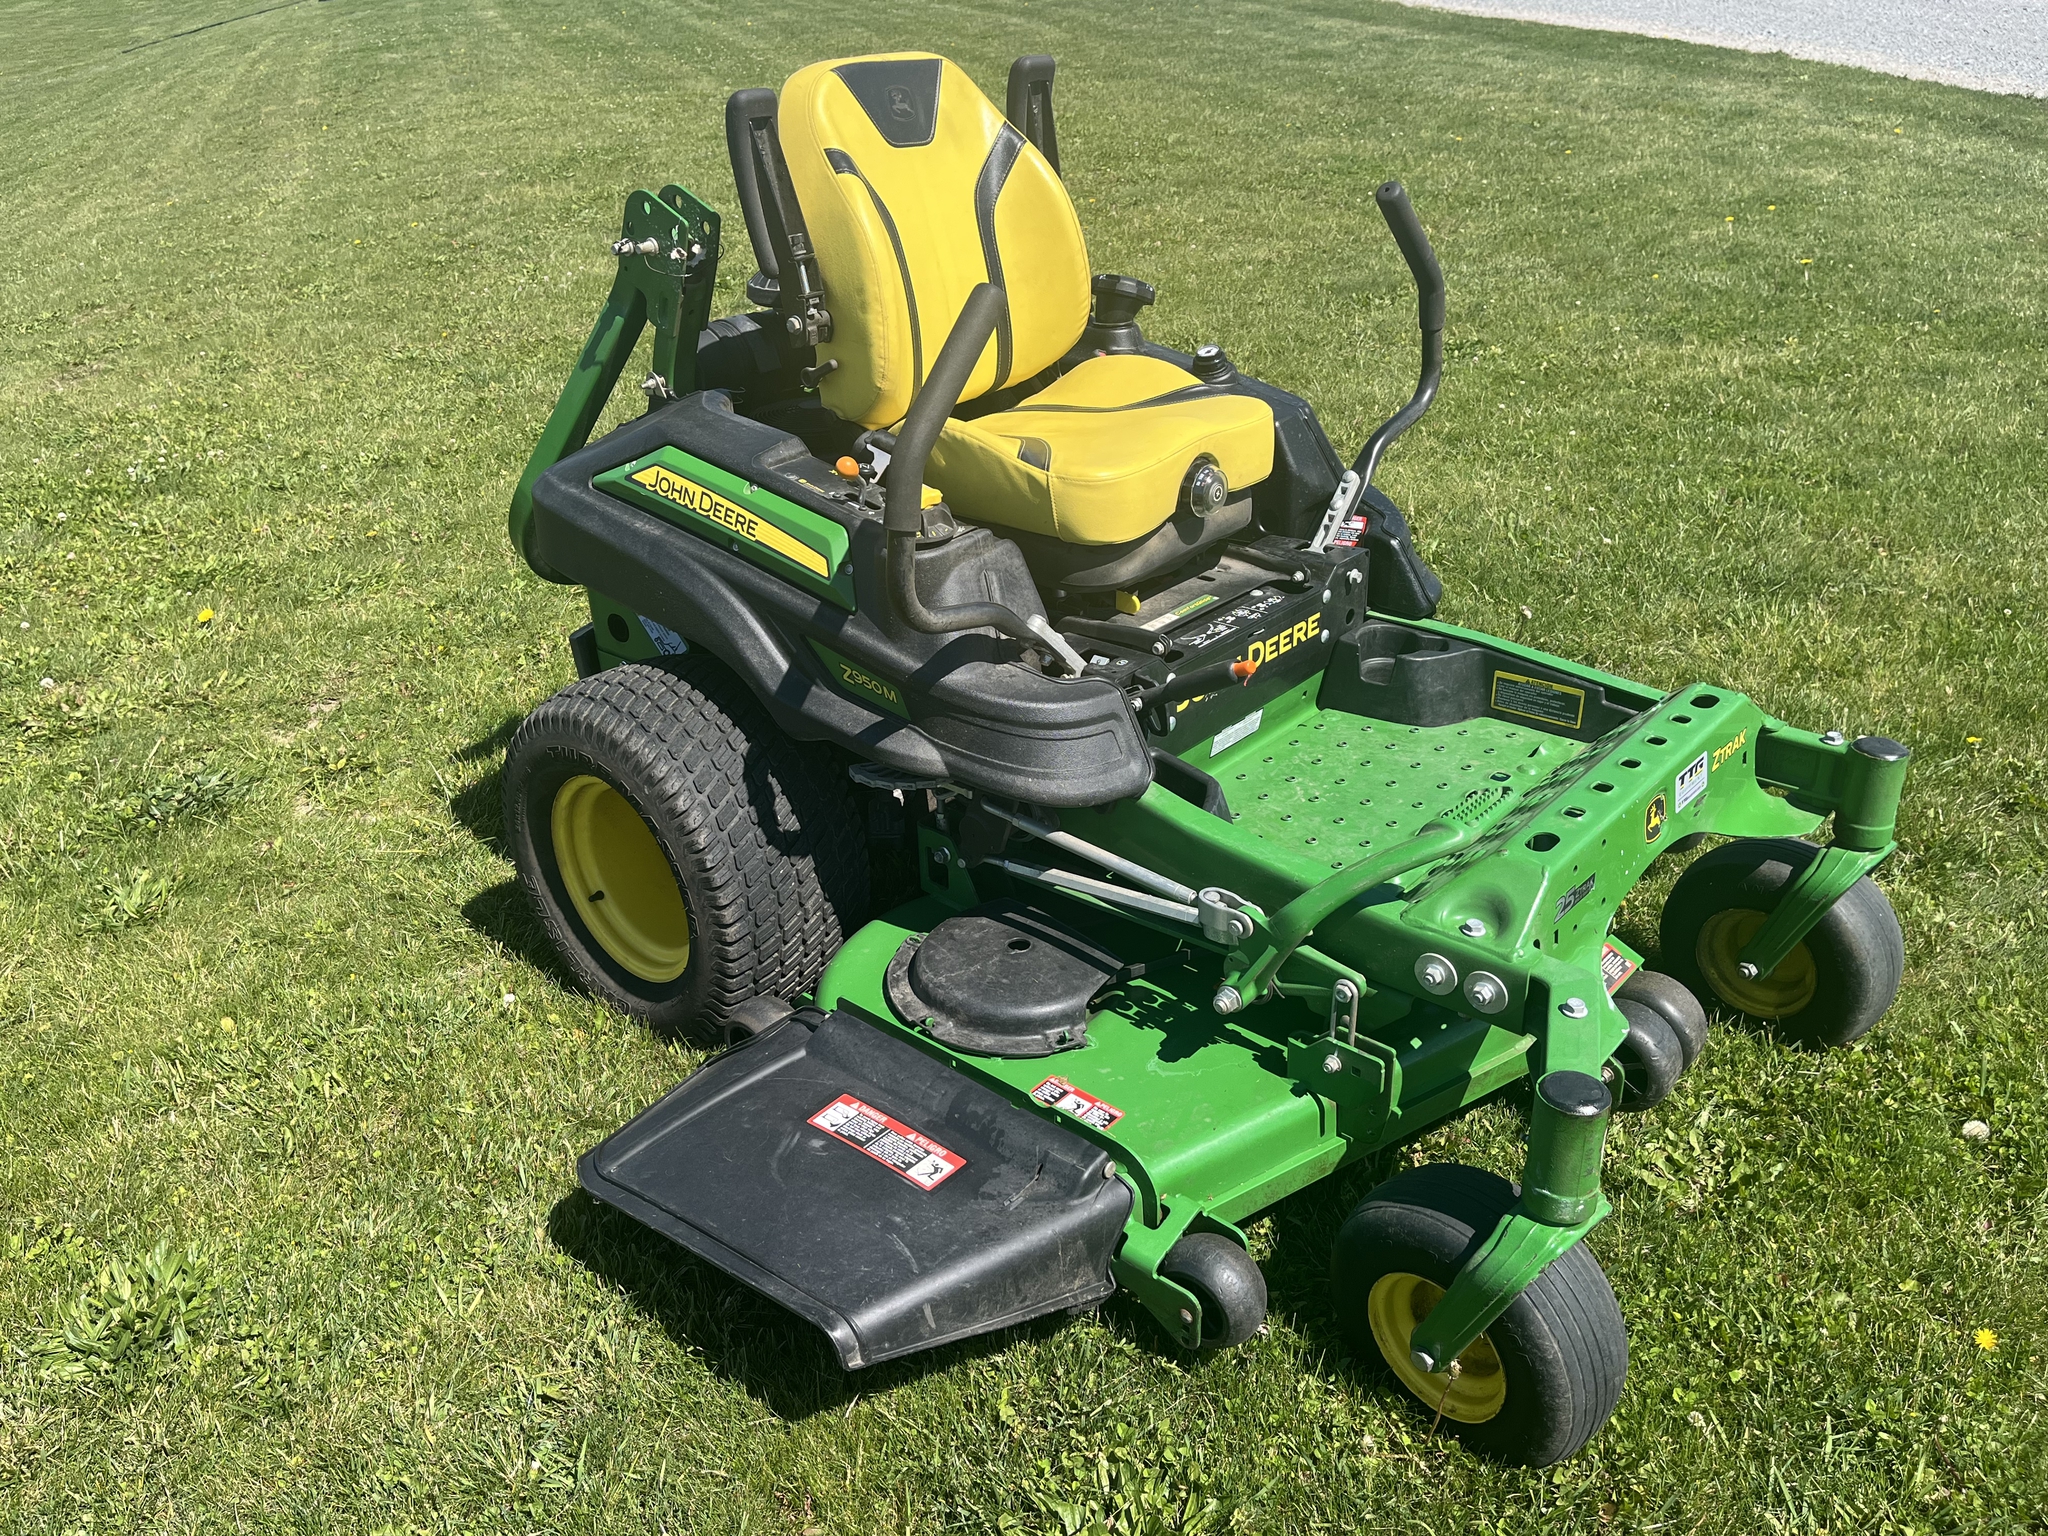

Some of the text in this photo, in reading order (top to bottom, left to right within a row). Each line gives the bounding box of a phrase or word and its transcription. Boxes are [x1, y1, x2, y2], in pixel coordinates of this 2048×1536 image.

[649, 469, 759, 539] JOHN DEERE
[1248, 612, 1321, 669] DEERE
[839, 663, 898, 704] Z950M
[1711, 728, 1747, 772] ZTRAK
[1679, 756, 1705, 787] TTG
[1553, 885, 1576, 924] 25
[858, 1104, 888, 1123] DANGER
[1100, 1102, 1123, 1117] PELIGRO
[914, 1136, 948, 1157] PELIGRO
